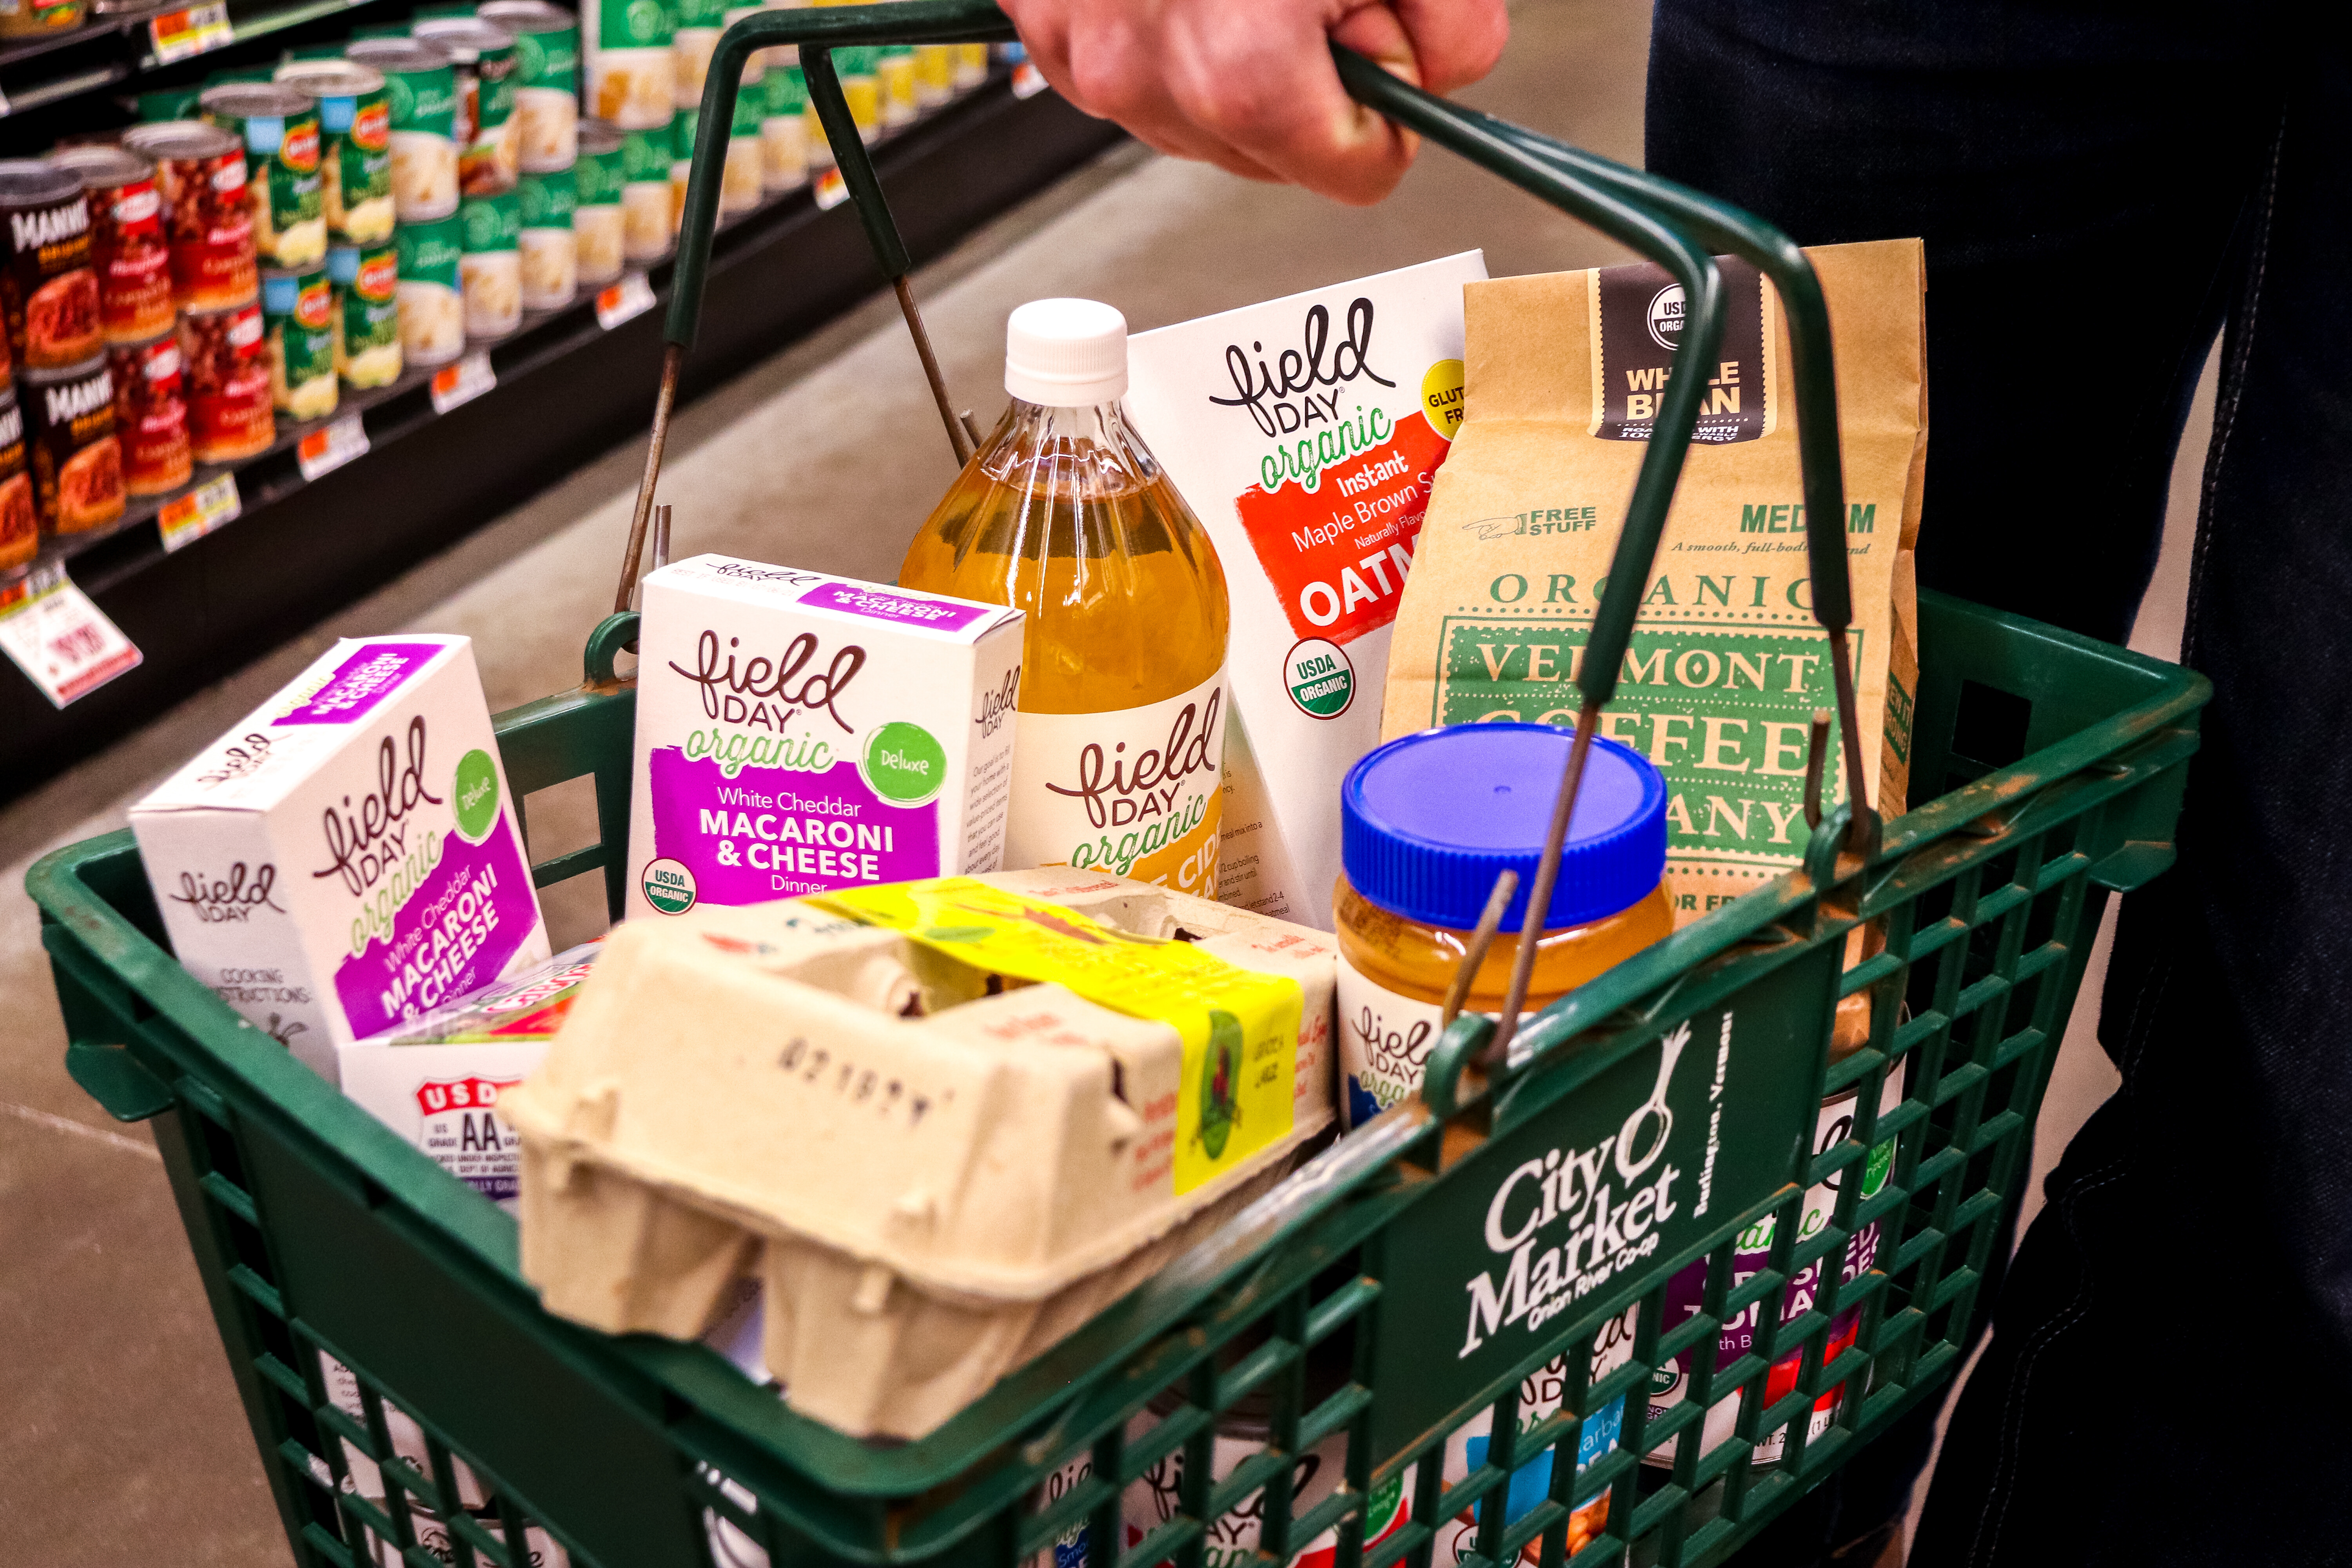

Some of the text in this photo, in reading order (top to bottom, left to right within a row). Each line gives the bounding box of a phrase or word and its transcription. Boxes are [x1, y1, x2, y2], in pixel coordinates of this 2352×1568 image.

[1209, 297, 1396, 438] field
[1626, 361, 1740, 392] WHE
[1626, 387, 1740, 420] BN
[1697, 425, 1739, 434] WITH
[1261, 405, 1391, 490] organic
[1336, 450, 1409, 498] Instant
[1291, 511, 1355, 553] Maple
[1354, 484, 1418, 524] Brown
[1530, 506, 1597, 523] FREE
[1530, 520, 1597, 536] STUFF
[1739, 504, 1877, 534] MEDM
[1354, 520, 1399, 550] Naturally
[1671, 542, 1683, 552] A
[1687, 542, 1740, 552] smooth,
[671, 568, 694, 578] BEST
[711, 575, 733, 585] USED
[705, 563, 822, 586] field
[726, 571, 769, 581] DAY
[833, 590, 956, 618] MACARONI
[855, 601, 941, 621] CHEESE
[860, 607, 902, 619] Dinner
[348, 656, 410, 700] CHEESE
[668, 629, 867, 734] field
[1296, 653, 1337, 680] USDA
[975, 665, 1021, 739] field
[1299, 675, 1348, 702] ORGANIC
[986, 711, 1004, 737] DAY
[686, 728, 833, 779] organic
[881, 749, 929, 776] Deluxe
[1045, 687, 1221, 829] field
[461, 776, 491, 811] Deluxe
[717, 786, 862, 818] White Cheddar
[970, 782, 982, 798] your
[313, 715, 443, 897] field
[700, 808, 894, 852] MACARONI
[1072, 793, 1207, 876] organic
[1246, 822, 1258, 833] into
[717, 840, 880, 881] & CHEESE
[1227, 861, 1238, 871] cup
[1237, 855, 1260, 867] boiling
[169, 862, 286, 923] field
[351, 830, 442, 954] organic
[655, 869, 686, 887] USDA
[771, 875, 828, 895] Dinner
[1223, 875, 1235, 886] and
[650, 887, 689, 903] ORGANIC
[1272, 891, 1285, 902] 2-4
[212, 906, 254, 923] DAY
[384, 864, 472, 973] White Cheddar
[381, 862, 499, 1020] MACARONI
[420, 900, 501, 1008] CHEESE
[220, 968, 283, 984] COOKING
[1376, 1053, 1418, 1084] DAY
[461, 1112, 502, 1151] AA
[1484, 1135, 1616, 1253] City
[1457, 1163, 1680, 1359] Market
[1528, 1290, 1572, 1332] Onion
[1574, 1259, 1612, 1298] River
